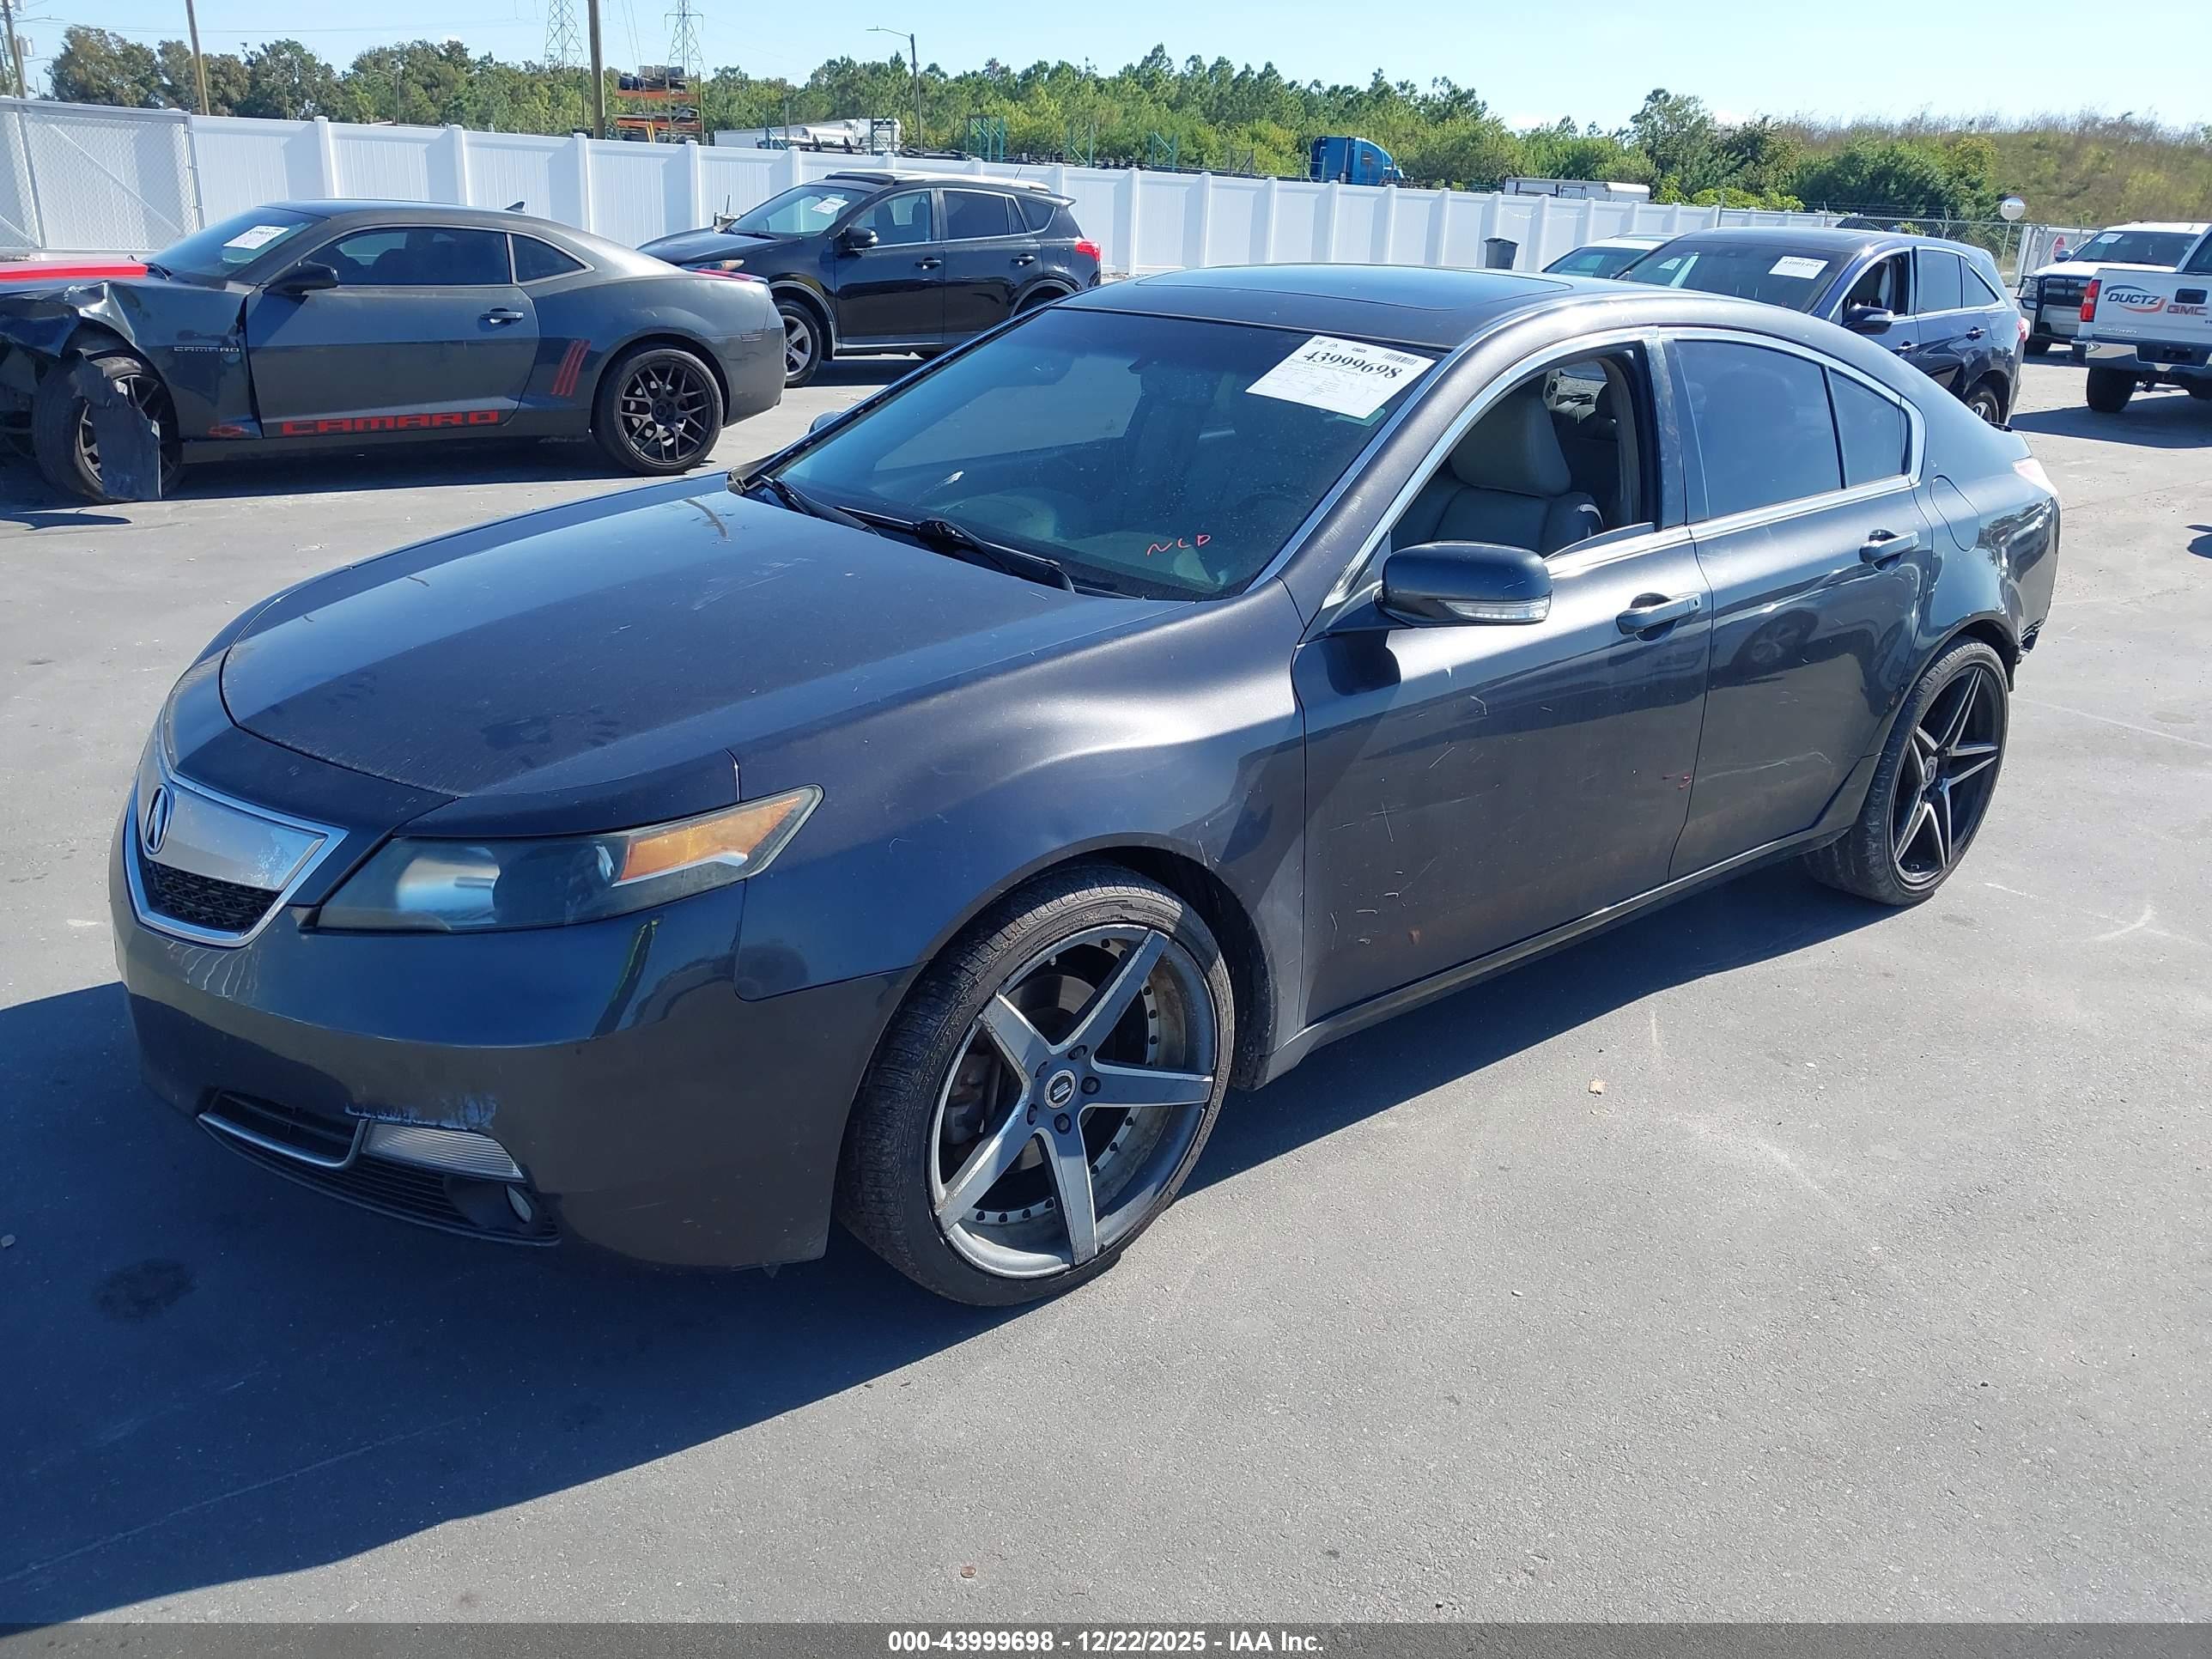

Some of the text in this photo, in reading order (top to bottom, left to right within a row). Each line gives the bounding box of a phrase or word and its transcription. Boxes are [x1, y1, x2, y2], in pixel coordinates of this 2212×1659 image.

[2107, 293, 2160, 305] DUCTZ
[2166, 305, 2209, 316] GMC
[1303, 350, 1403, 380] 43999698
[282, 410, 499, 435] CAMARO
